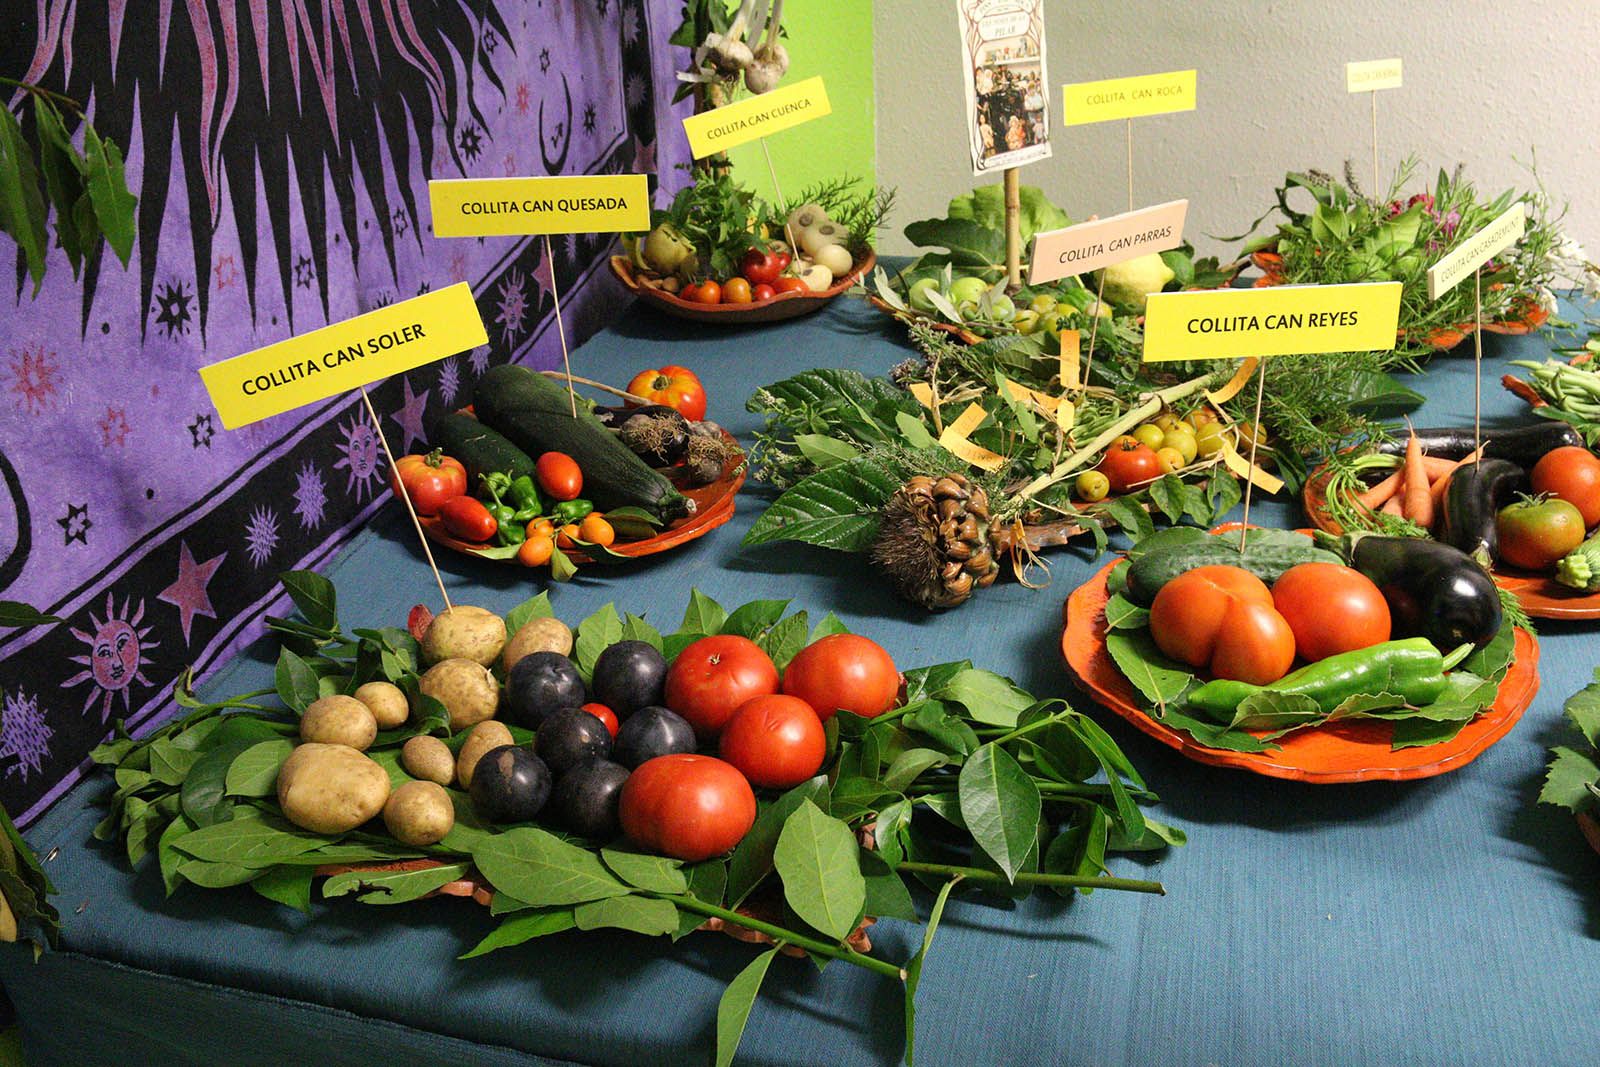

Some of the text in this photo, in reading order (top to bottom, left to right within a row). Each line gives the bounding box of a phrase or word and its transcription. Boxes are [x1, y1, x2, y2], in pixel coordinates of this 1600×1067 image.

[1086, 85, 1183, 105] COLLITA CAN ROCA
[706, 98, 812, 140] COLLITA CAN CUENCA
[461, 197, 628, 215] COLLITA CAN QUESADA
[1059, 225, 1172, 264] COLLITA CAN PARRAS
[1187, 311, 1359, 334] COLLITA CAN REYES
[242, 323, 426, 396] COLLITA CAN SOLER
